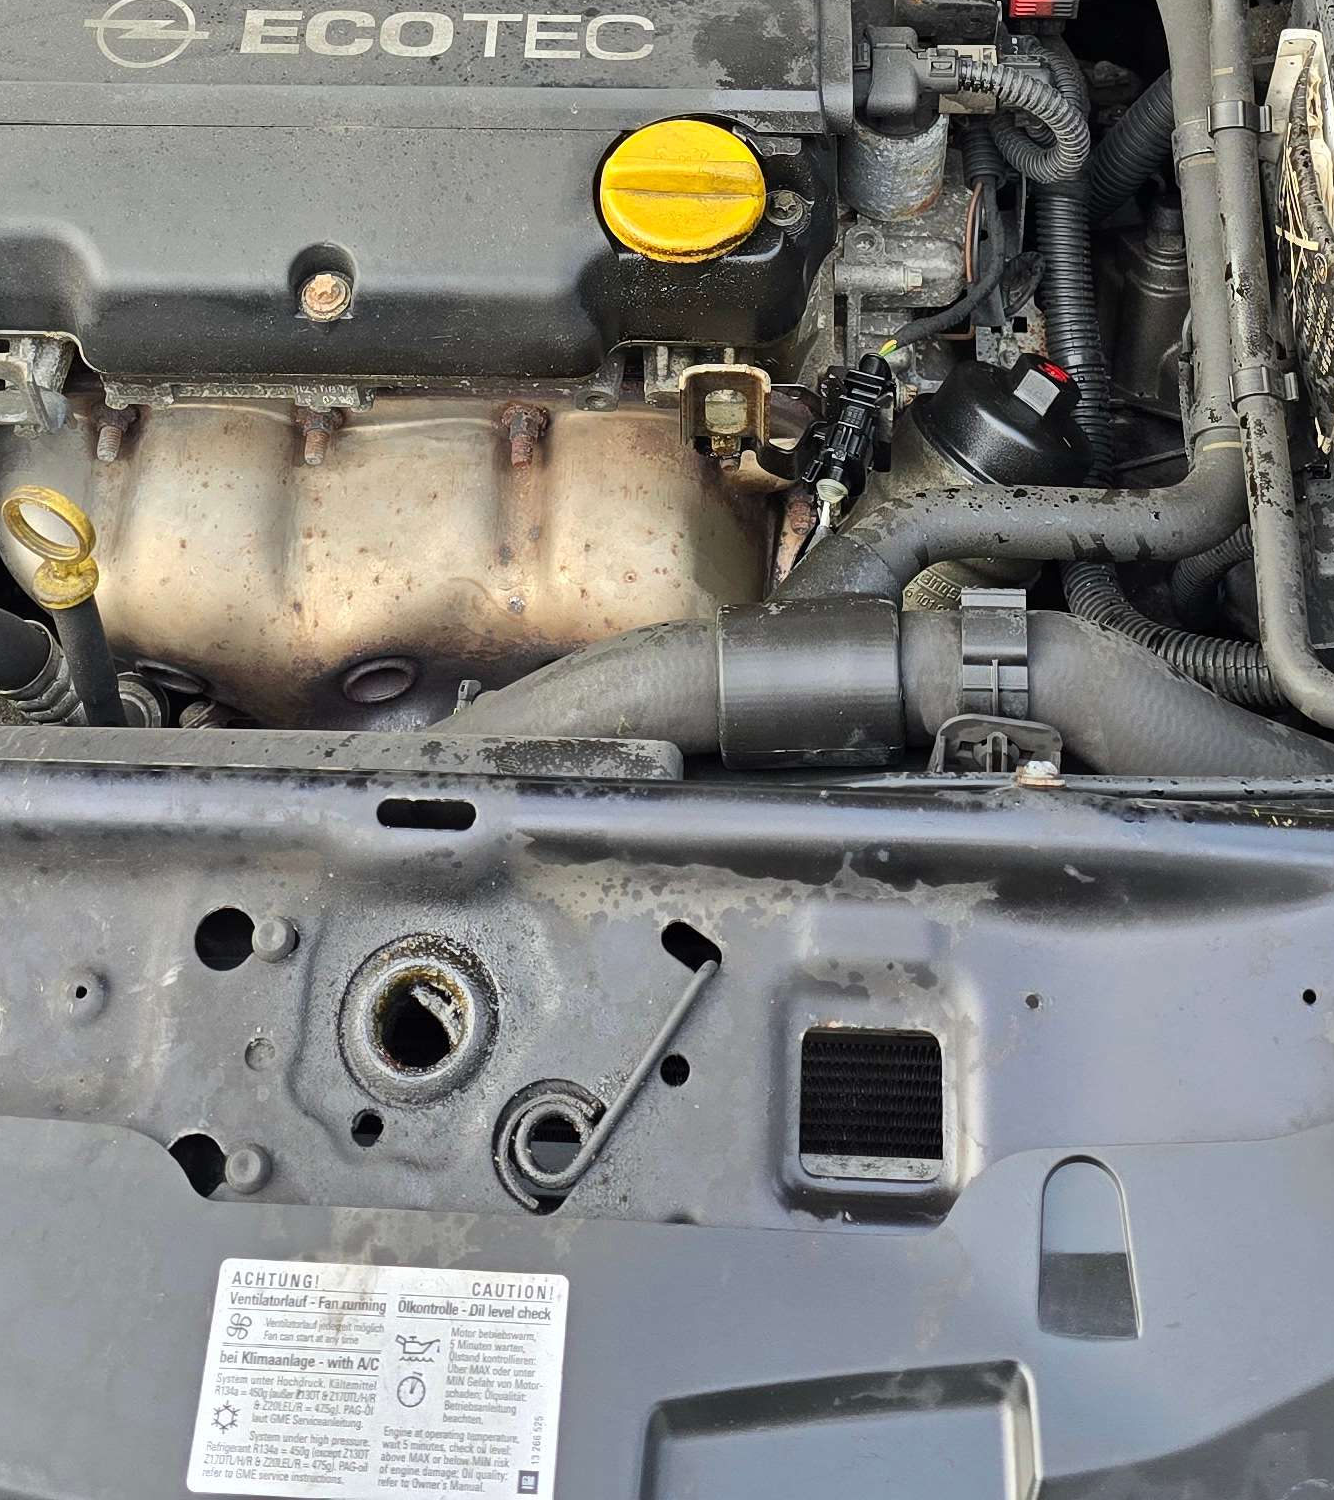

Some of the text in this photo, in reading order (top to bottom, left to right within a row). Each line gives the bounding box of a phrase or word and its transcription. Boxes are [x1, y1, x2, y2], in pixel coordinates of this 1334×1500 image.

[239, 9, 656, 61] ECOTEC
[232, 1271, 319, 1288] ACHTUNG!
[472, 1282, 554, 1300] CAUTION!
[231, 1292, 307, 1308] Ventilatorlauf
[319, 1296, 339, 1309] Fan
[342, 1298, 386, 1315] running
[398, 1297, 458, 1315] Ölkontrolle
[468, 1304, 485, 1317] Oil
[487, 1304, 514, 1318] level
[517, 1306, 551, 1320] check
[354, 1323, 384, 1334] möglich
[451, 1327, 475, 1338] Motor
[264, 1331, 278, 1341] Fan
[280, 1333, 294, 1342] can
[296, 1333, 313, 1342] start
[325, 1336, 339, 1346] any
[342, 1335, 359, 1345] time
[458, 1340, 492, 1351] Minuten
[220, 1350, 237, 1364] bei
[242, 1352, 315, 1370] Klimaanlage
[327, 1356, 353, 1370] with
[357, 1357, 379, 1371] A/C
[470, 1364, 491, 1376] MAX
[492, 1366, 511, 1377] oder
[514, 1368, 535, 1378] unter
[217, 1373, 247, 1386] System
[251, 1376, 274, 1386] unter
[328, 1378, 377, 1390] Kältemittel
[446, 1375, 543, 1390] MIN Gefahr von Motor-
[215, 1386, 238, 1397] R134a
[248, 1387, 267, 1399] 450g
[444, 1400, 517, 1416] Betriebsanleitung
[270, 1414, 290, 1424] GME
[249, 1430, 280, 1443] System
[283, 1433, 307, 1444] under
[311, 1435, 329, 1447] high
[383, 1425, 412, 1439] Engine
[414, 1428, 423, 1437] at
[425, 1429, 464, 1442] operating
[207, 1441, 251, 1454] Refrigerant
[253, 1444, 278, 1455] R134a
[289, 1445, 309, 1458] 450g
[382, 1440, 400, 1450] wait
[449, 1443, 473, 1454] check
[476, 1444, 487, 1454] oil
[381, 1452, 510, 1468] above MAX or below MIN risk
[203, 1467, 222, 1477] refer
[225, 1469, 234, 1478] to
[236, 1469, 256, 1479] GME
[258, 1471, 289, 1481] service
[379, 1464, 388, 1474] of
[390, 1467, 420, 1478] engine
[462, 1468, 473, 1479] Oil
[378, 1477, 399, 1487] refer
[401, 1478, 410, 1488] to
[412, 1479, 448, 1490] Owner's
